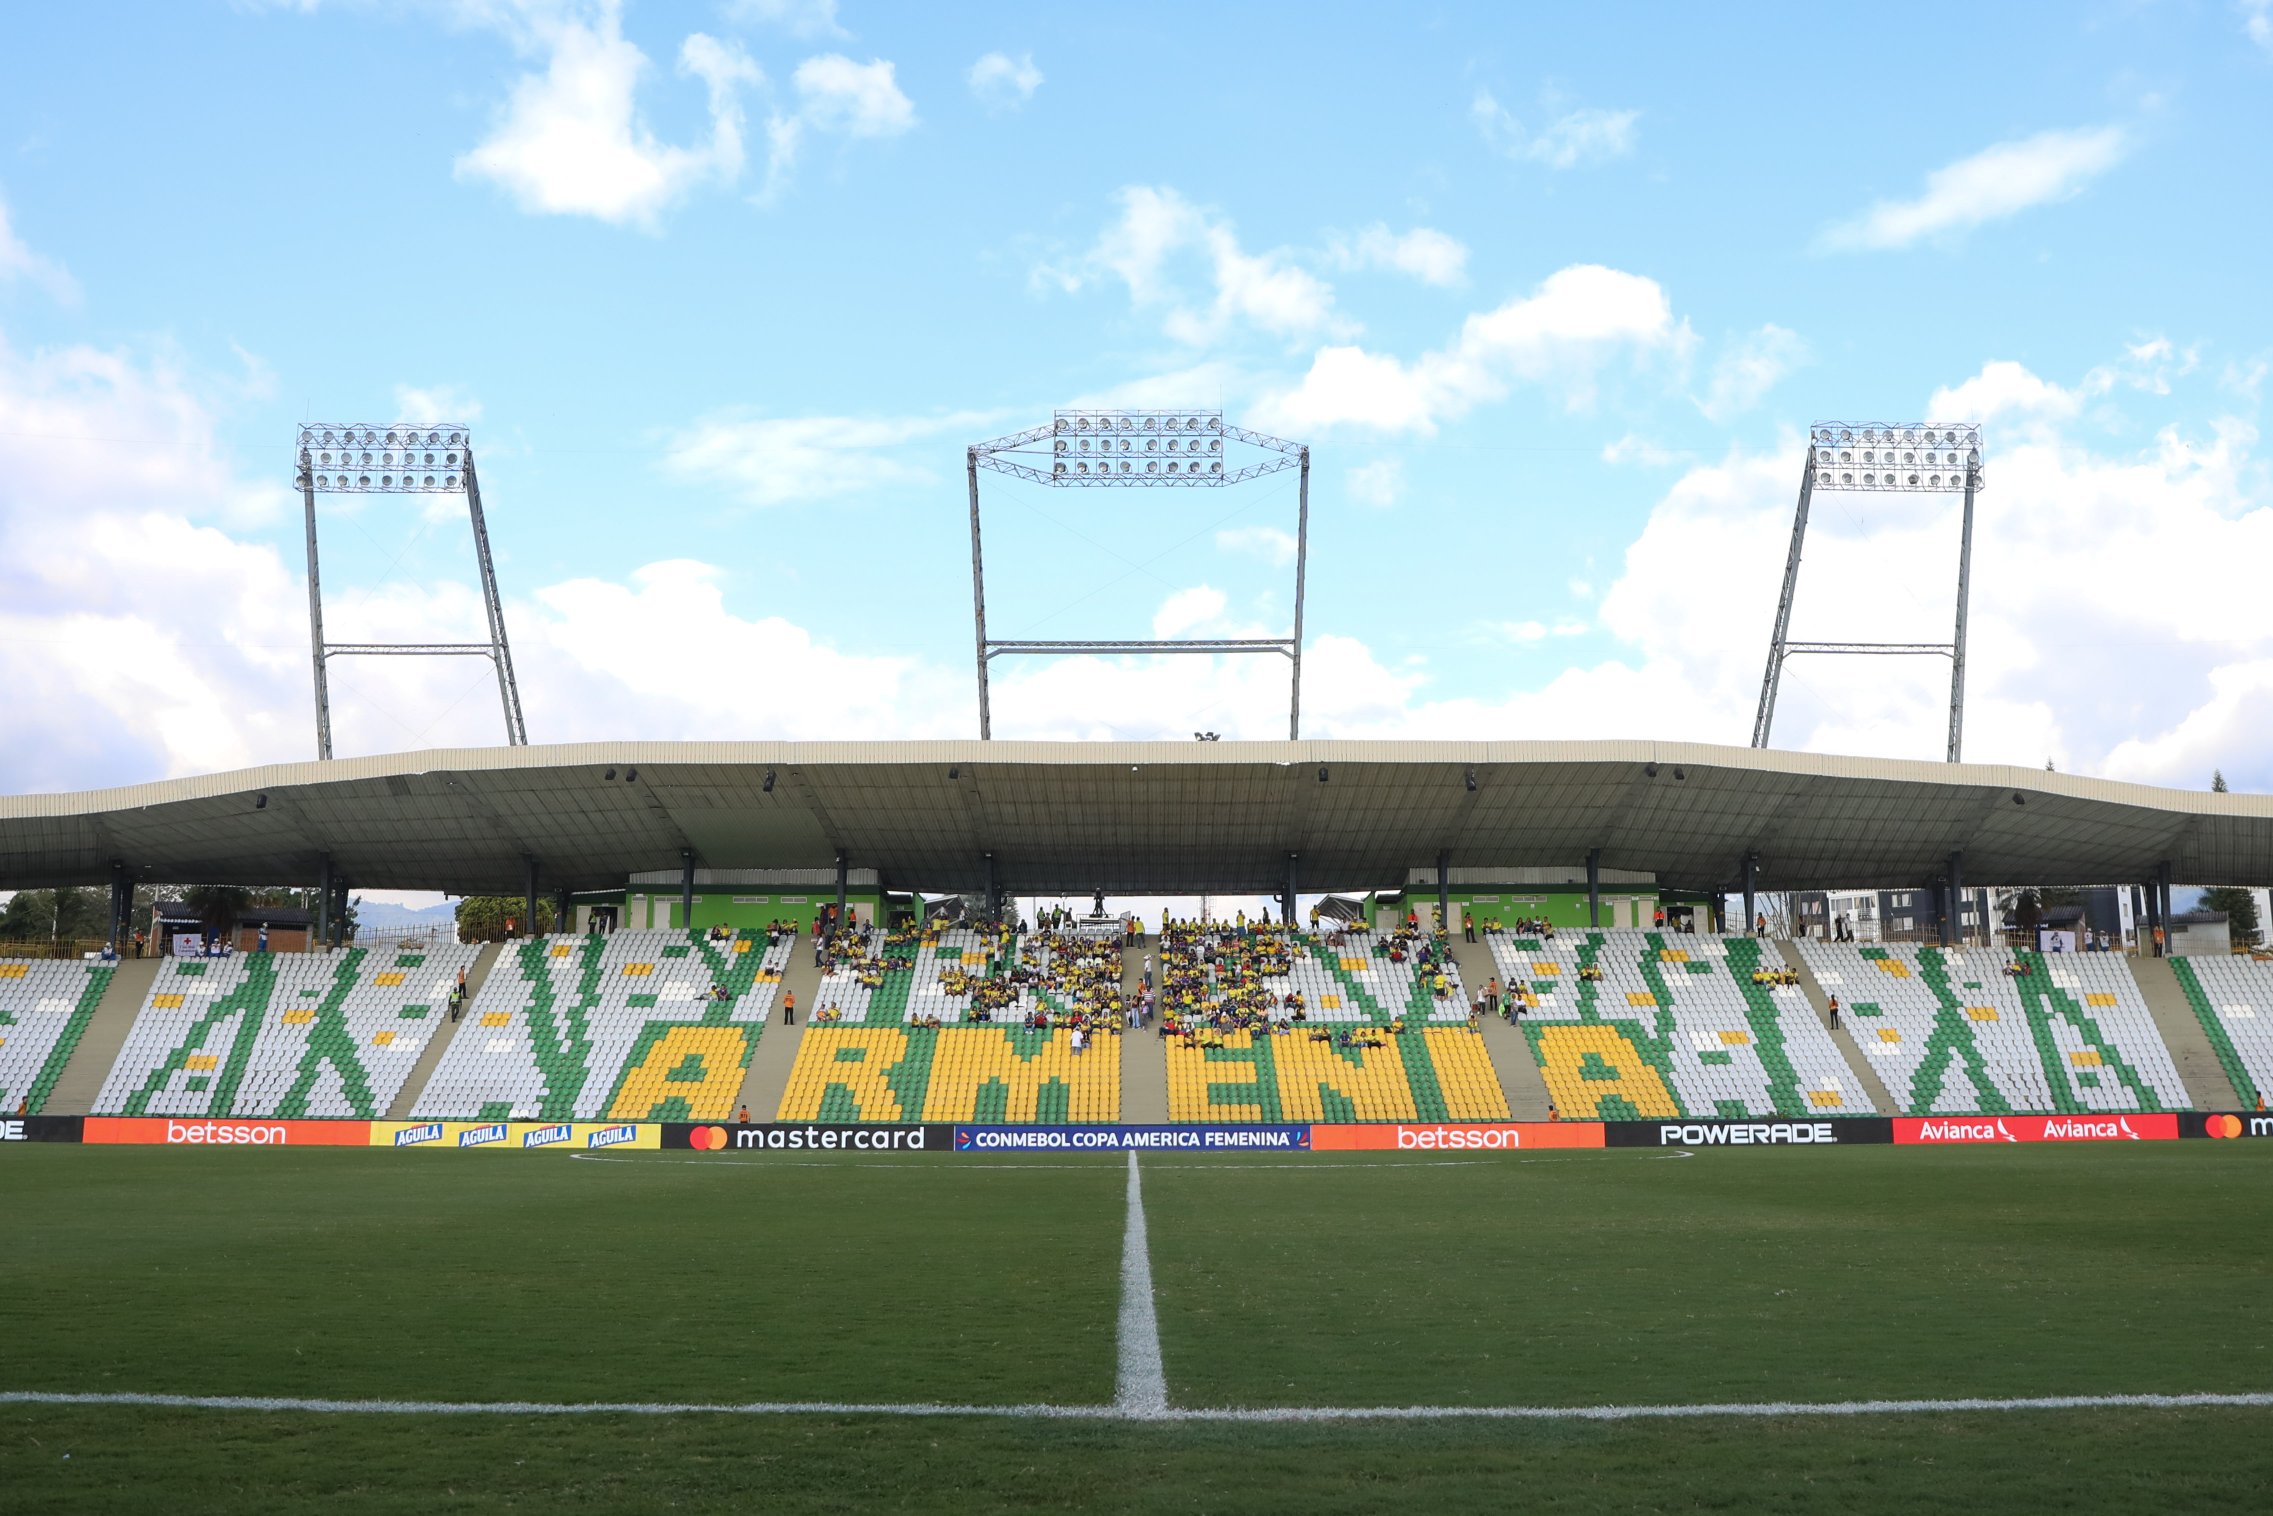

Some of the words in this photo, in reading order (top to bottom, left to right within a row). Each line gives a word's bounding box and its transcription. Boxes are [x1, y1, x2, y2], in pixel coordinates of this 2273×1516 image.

[167, 1120, 286, 1144] betsson
[396, 1125, 439, 1146] AGUILA
[460, 1126, 504, 1147] AGUILA
[525, 1126, 568, 1148] AGUILA
[590, 1127, 633, 1148] AGUILA
[736, 1126, 925, 1149] mastercard
[975, 1132, 1071, 1147] CONMEBOL
[1072, 1132, 1119, 1147] COPA
[1121, 1132, 1201, 1147] AMERICA
[1205, 1131, 1290, 1146] FEMENINA
[1397, 1126, 1519, 1148] betsson
[1660, 1123, 1833, 1144] POWERADE
[1920, 1121, 1994, 1140] Avianca
[2044, 1120, 2117, 1138] Avianca
